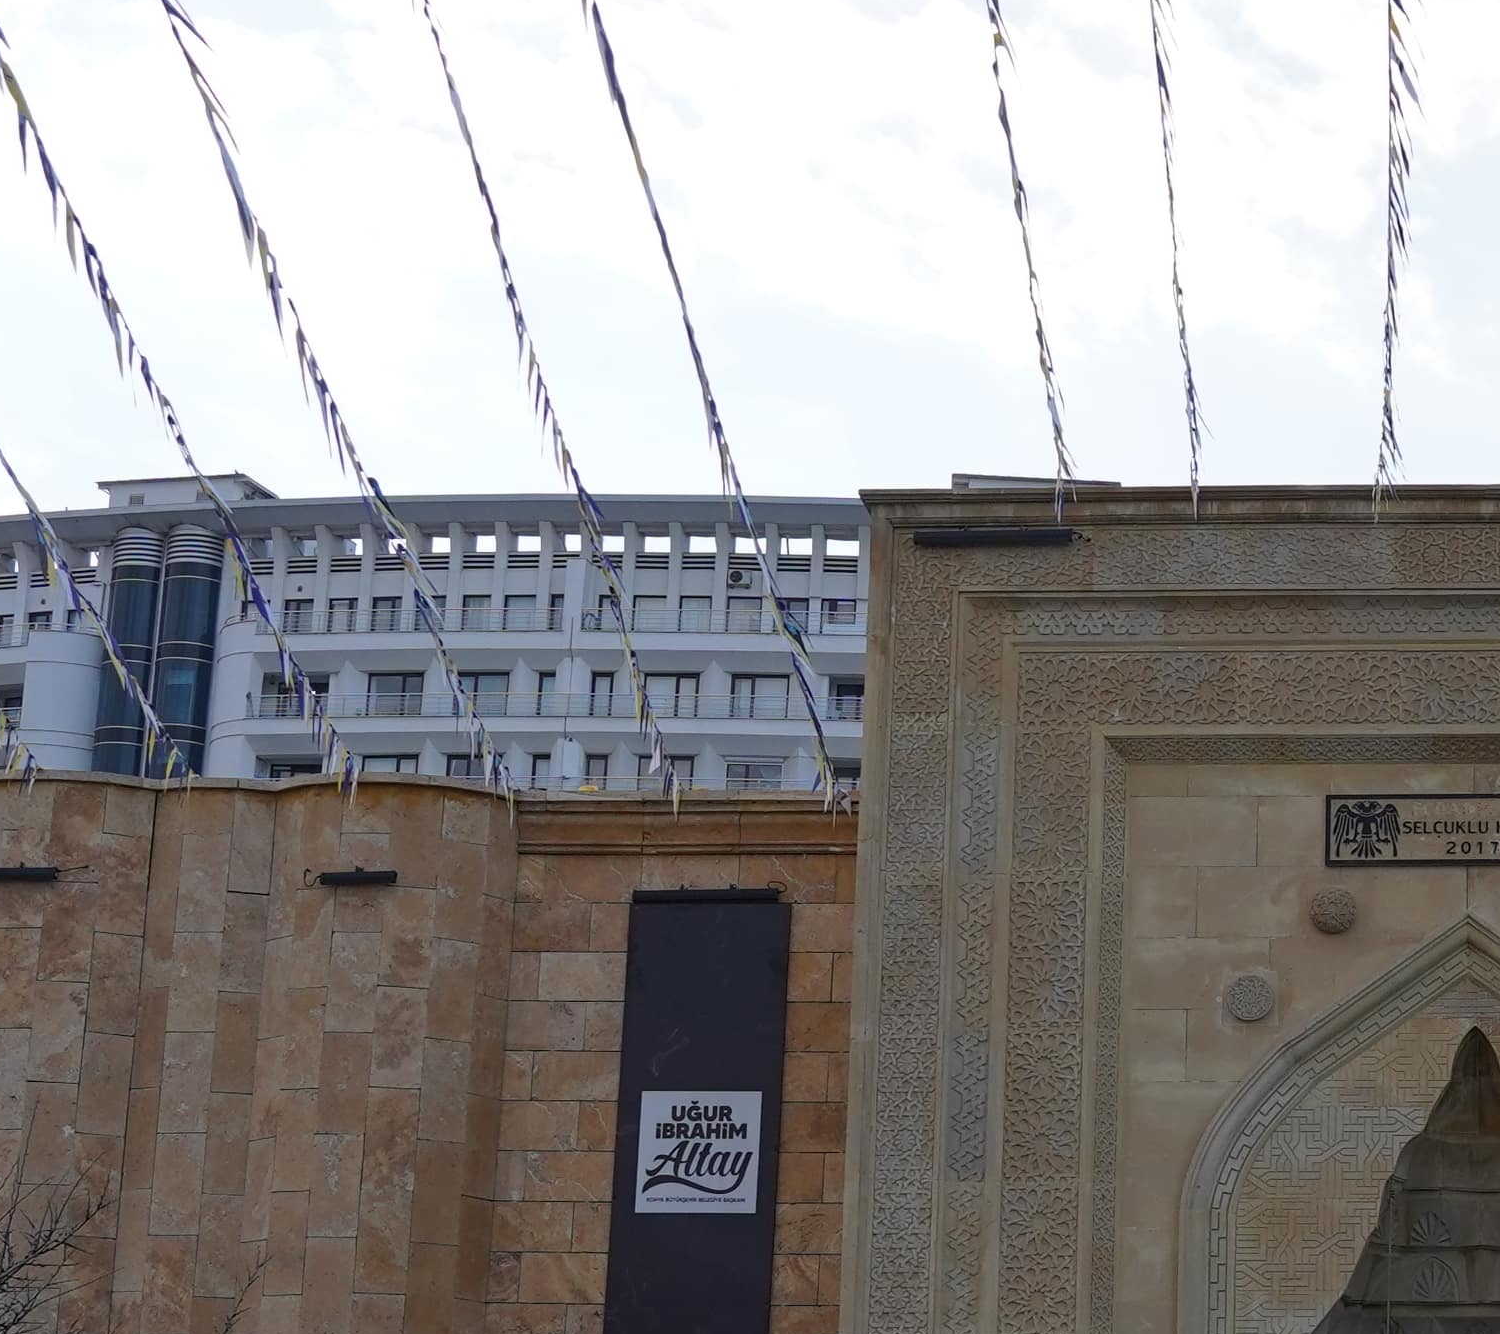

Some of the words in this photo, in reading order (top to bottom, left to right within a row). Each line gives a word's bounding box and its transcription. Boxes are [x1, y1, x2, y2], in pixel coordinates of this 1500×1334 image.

[1403, 820, 1489, 838] SELÇUKLU
[1446, 841, 1500, 855] 2017
[671, 1100, 733, 1122] UĞUR
[642, 1140, 753, 1194] Altay
